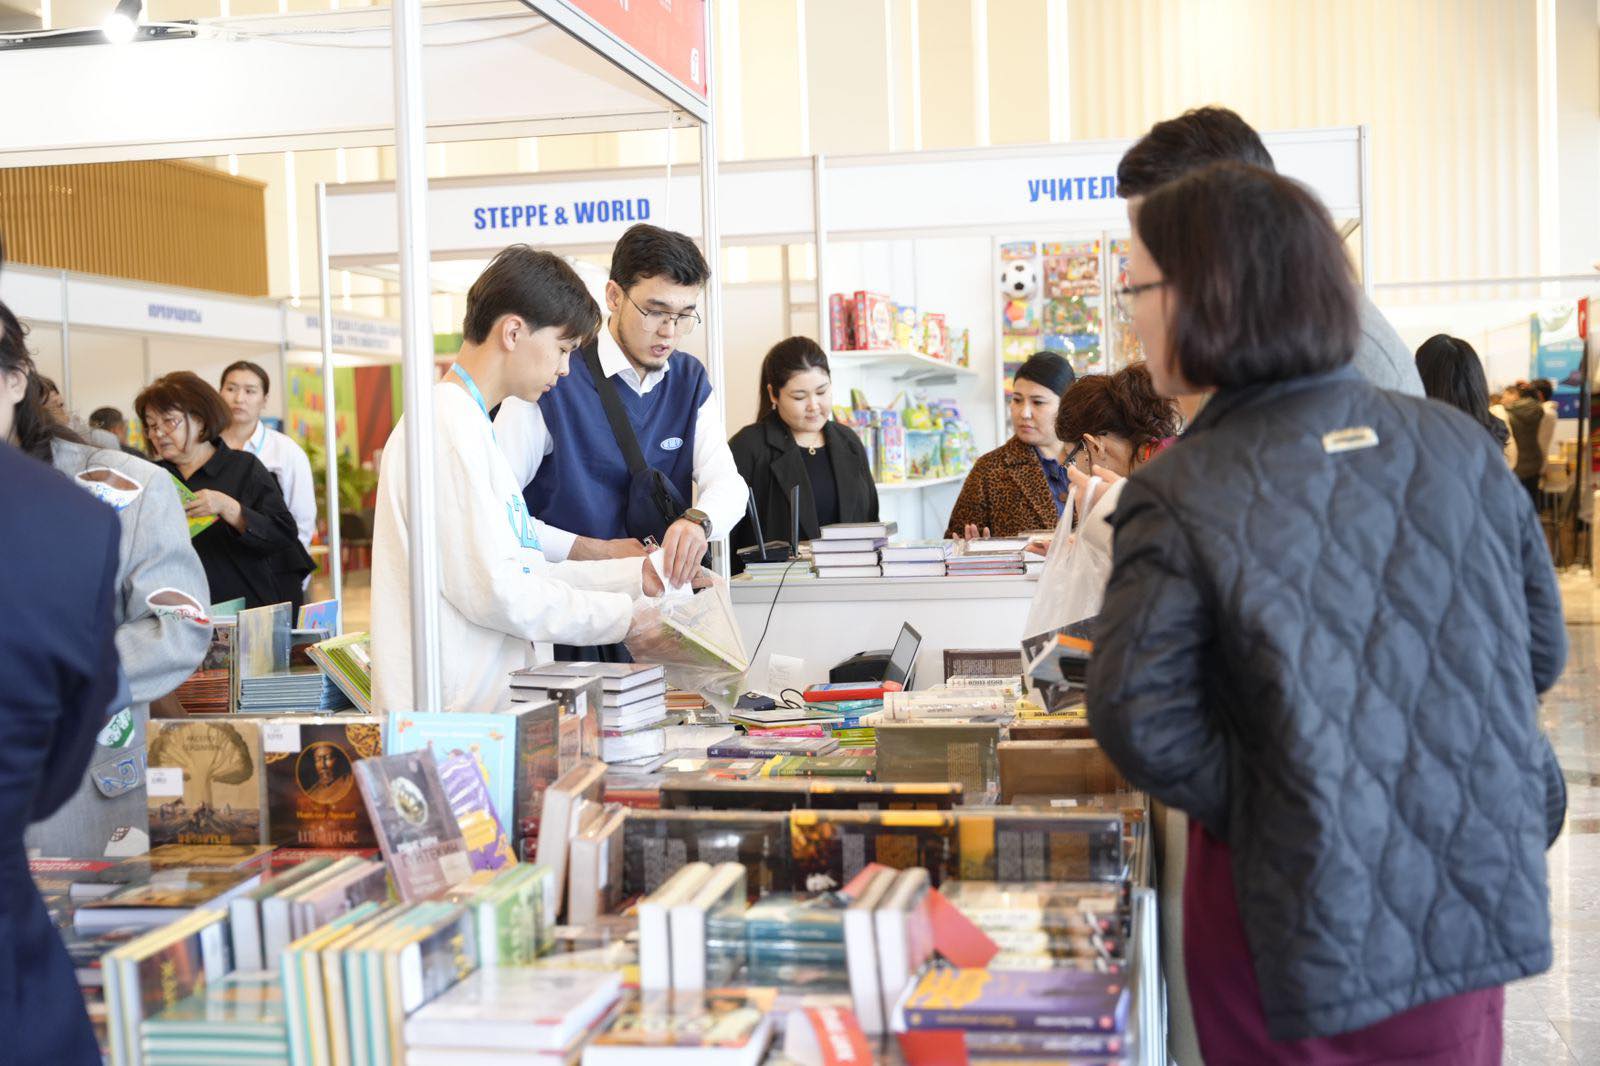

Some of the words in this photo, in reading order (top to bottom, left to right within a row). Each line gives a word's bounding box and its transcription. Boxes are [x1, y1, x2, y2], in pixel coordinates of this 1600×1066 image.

[1028, 176, 1118, 202] УЧИТЕЛ
[474, 205, 548, 229] STEPPE
[554, 206, 569, 225] &
[574, 199, 650, 223] WORLD
